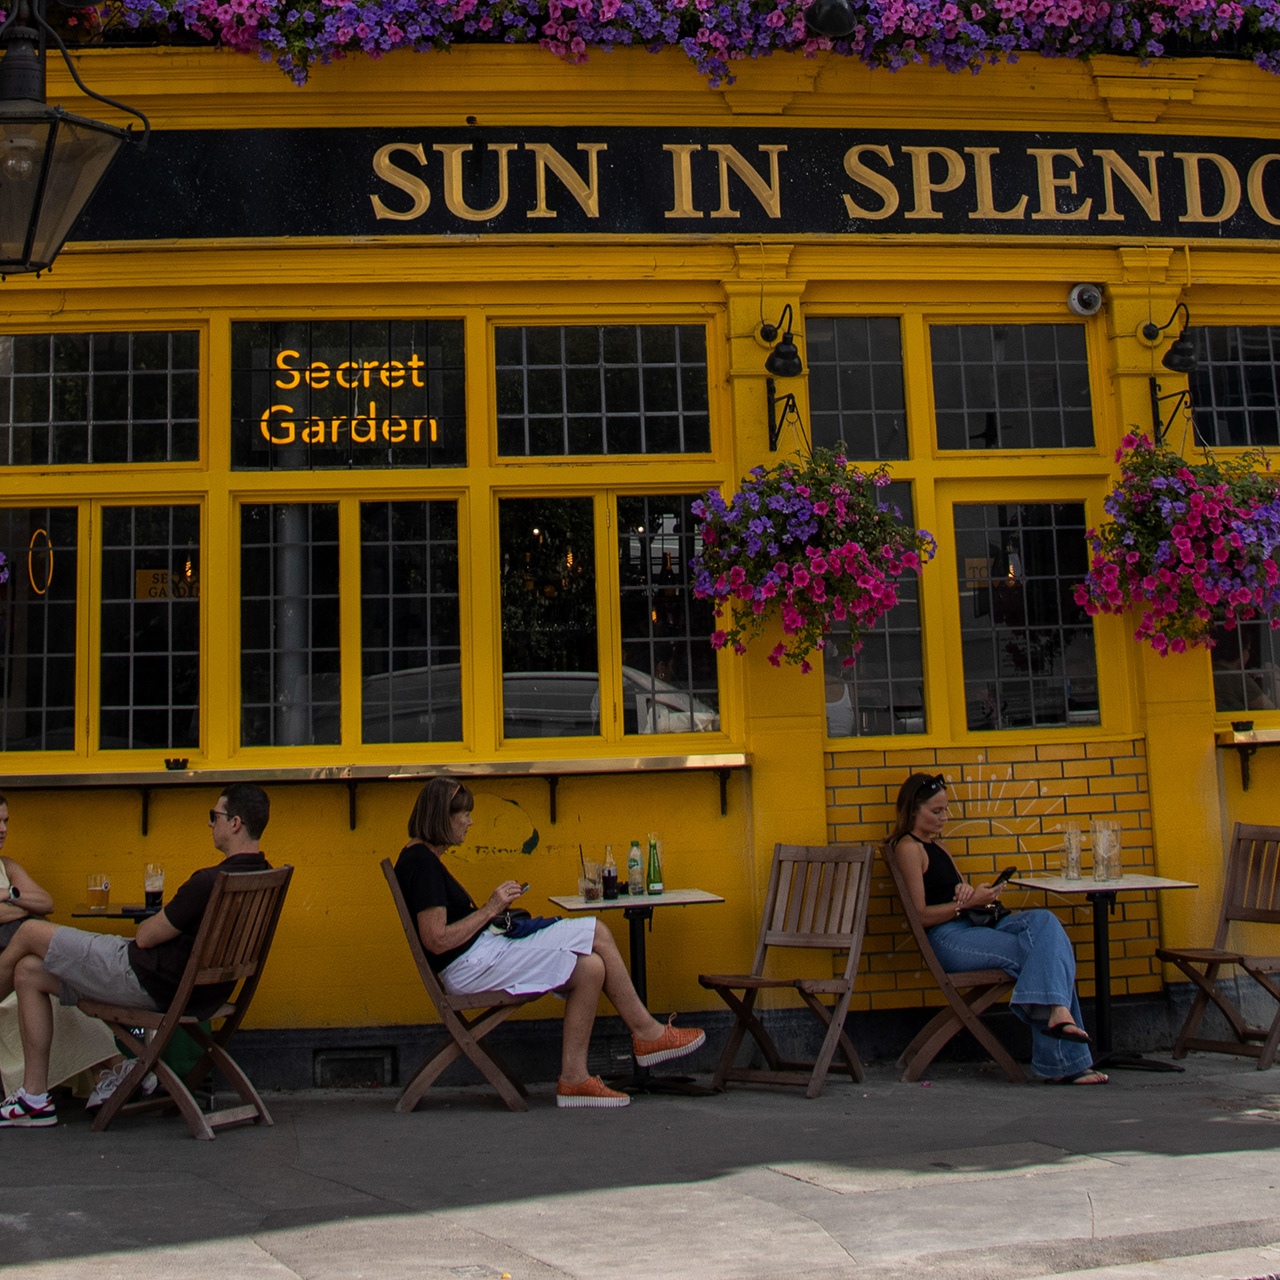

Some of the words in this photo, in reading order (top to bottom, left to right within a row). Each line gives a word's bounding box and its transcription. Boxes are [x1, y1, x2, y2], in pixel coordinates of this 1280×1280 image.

[369, 140, 608, 222] SUN
[660, 141, 790, 221] IN
[275, 349, 425, 389] Secret
[260, 400, 438, 445] Garden
